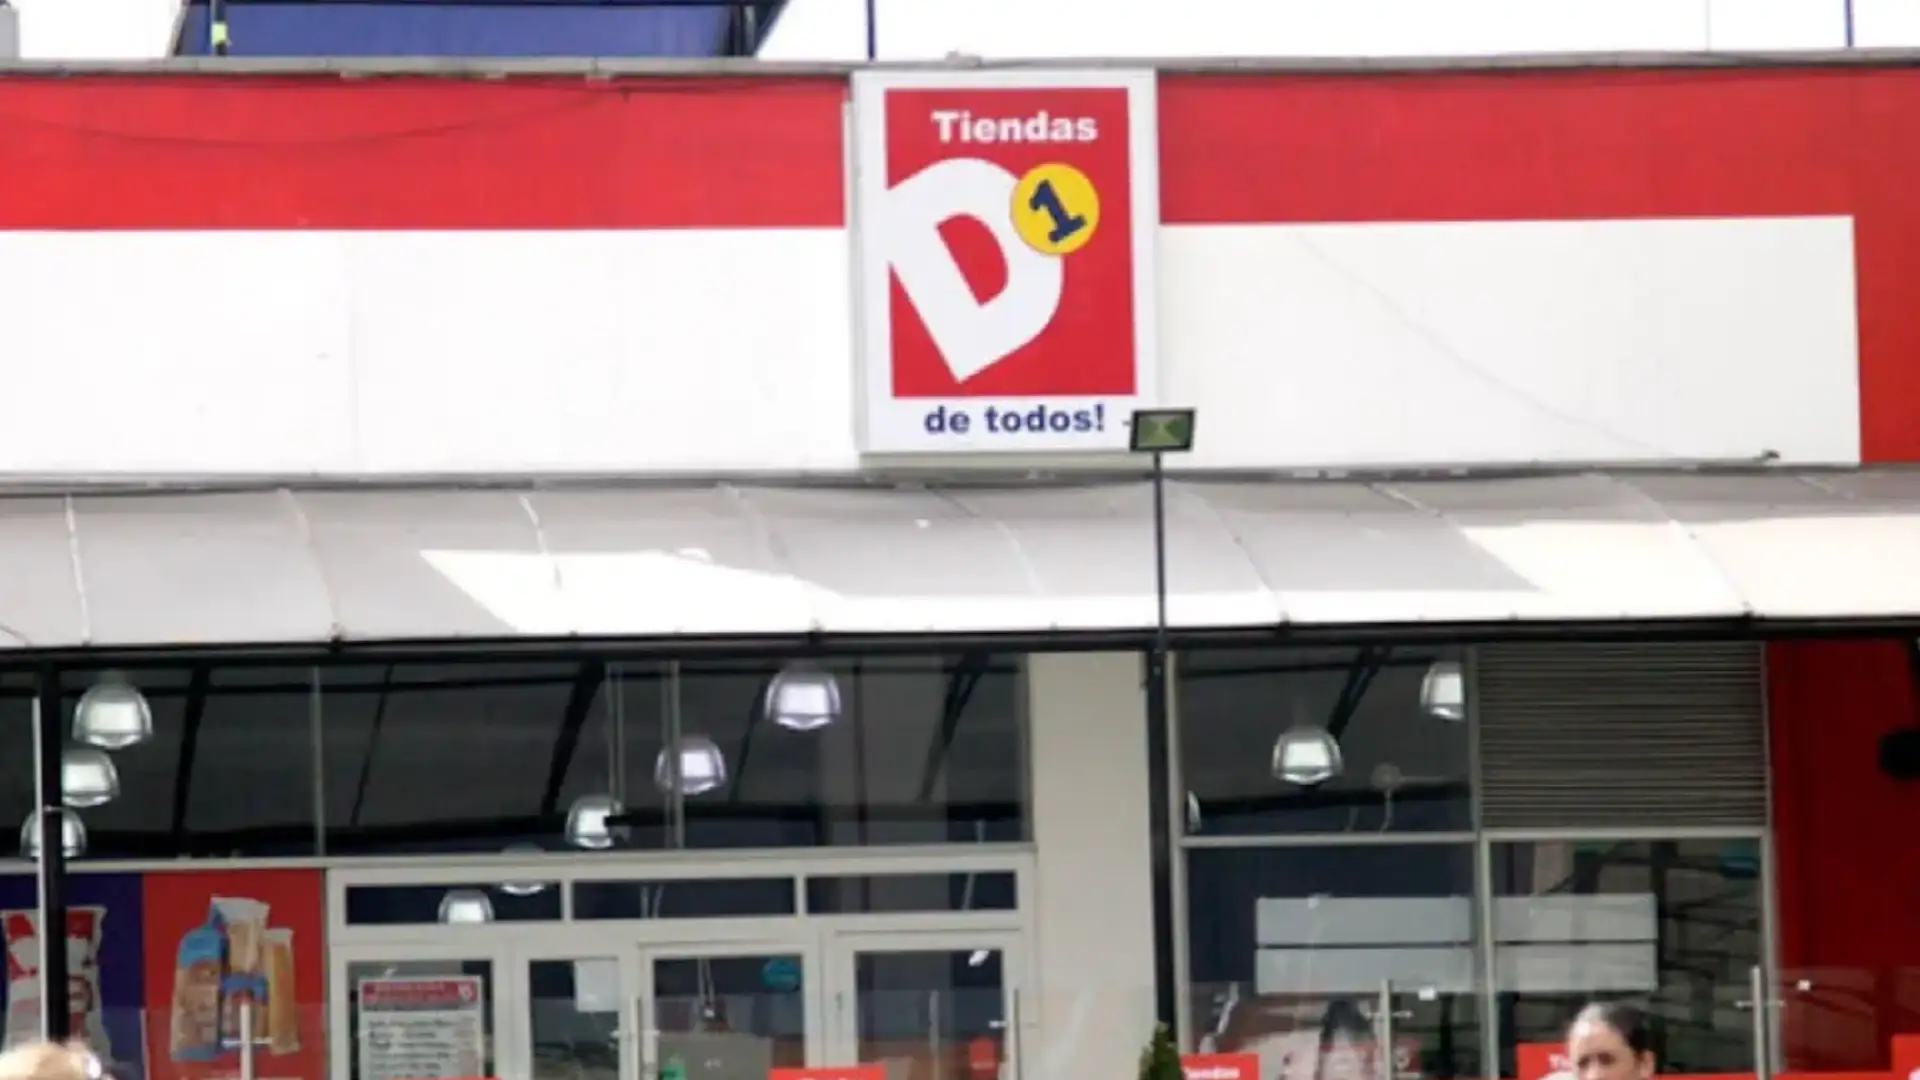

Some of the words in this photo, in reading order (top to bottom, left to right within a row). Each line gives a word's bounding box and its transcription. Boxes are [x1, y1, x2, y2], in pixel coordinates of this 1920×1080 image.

[931, 110, 1098, 143] Tiendas
[924, 404, 970, 433] de
[985, 404, 1104, 433] todos!
